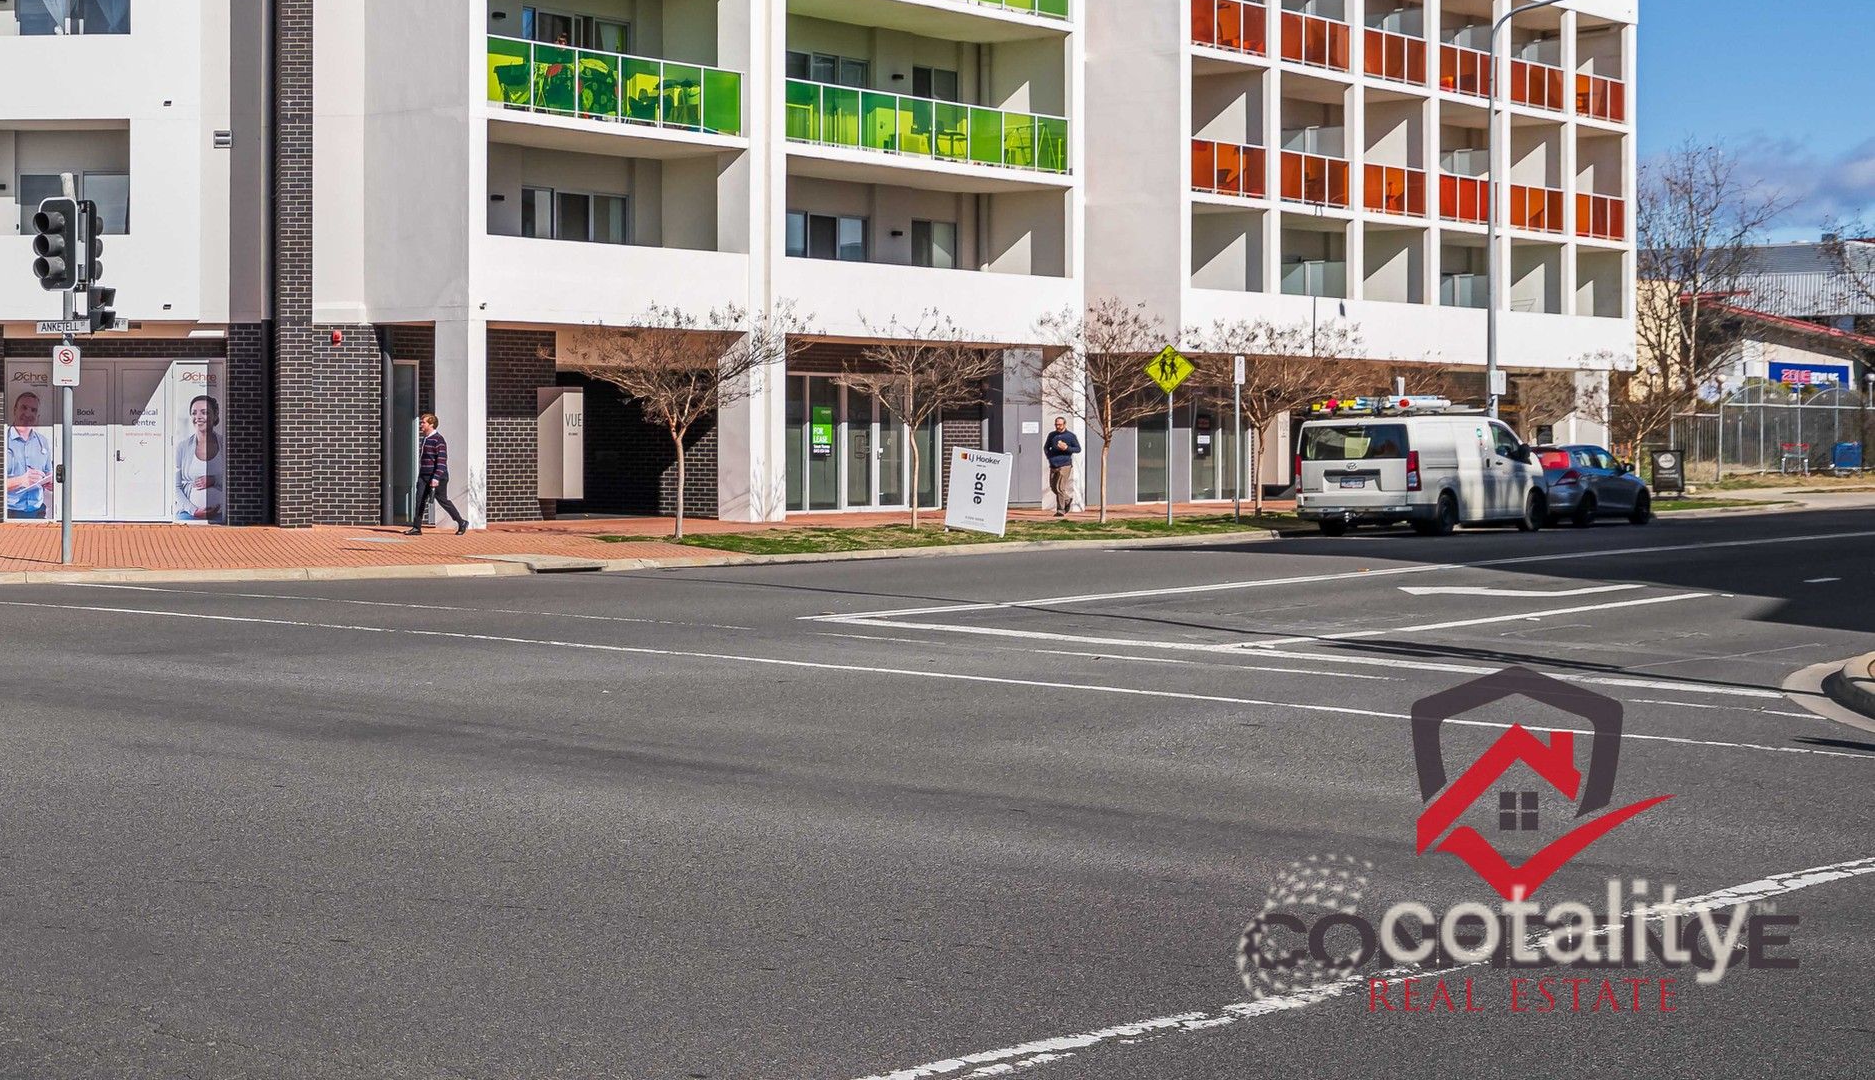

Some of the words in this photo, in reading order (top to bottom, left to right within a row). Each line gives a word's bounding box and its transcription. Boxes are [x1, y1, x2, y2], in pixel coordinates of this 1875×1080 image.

[40, 322, 79, 332] ANKETELL
[76, 408, 95, 416] Book
[129, 408, 159, 416] Medical
[131, 418, 157, 427] Centre
[564, 413, 582, 427] VUE
[975, 455, 1001, 465] Hooker
[973, 472, 987, 505] Sale
